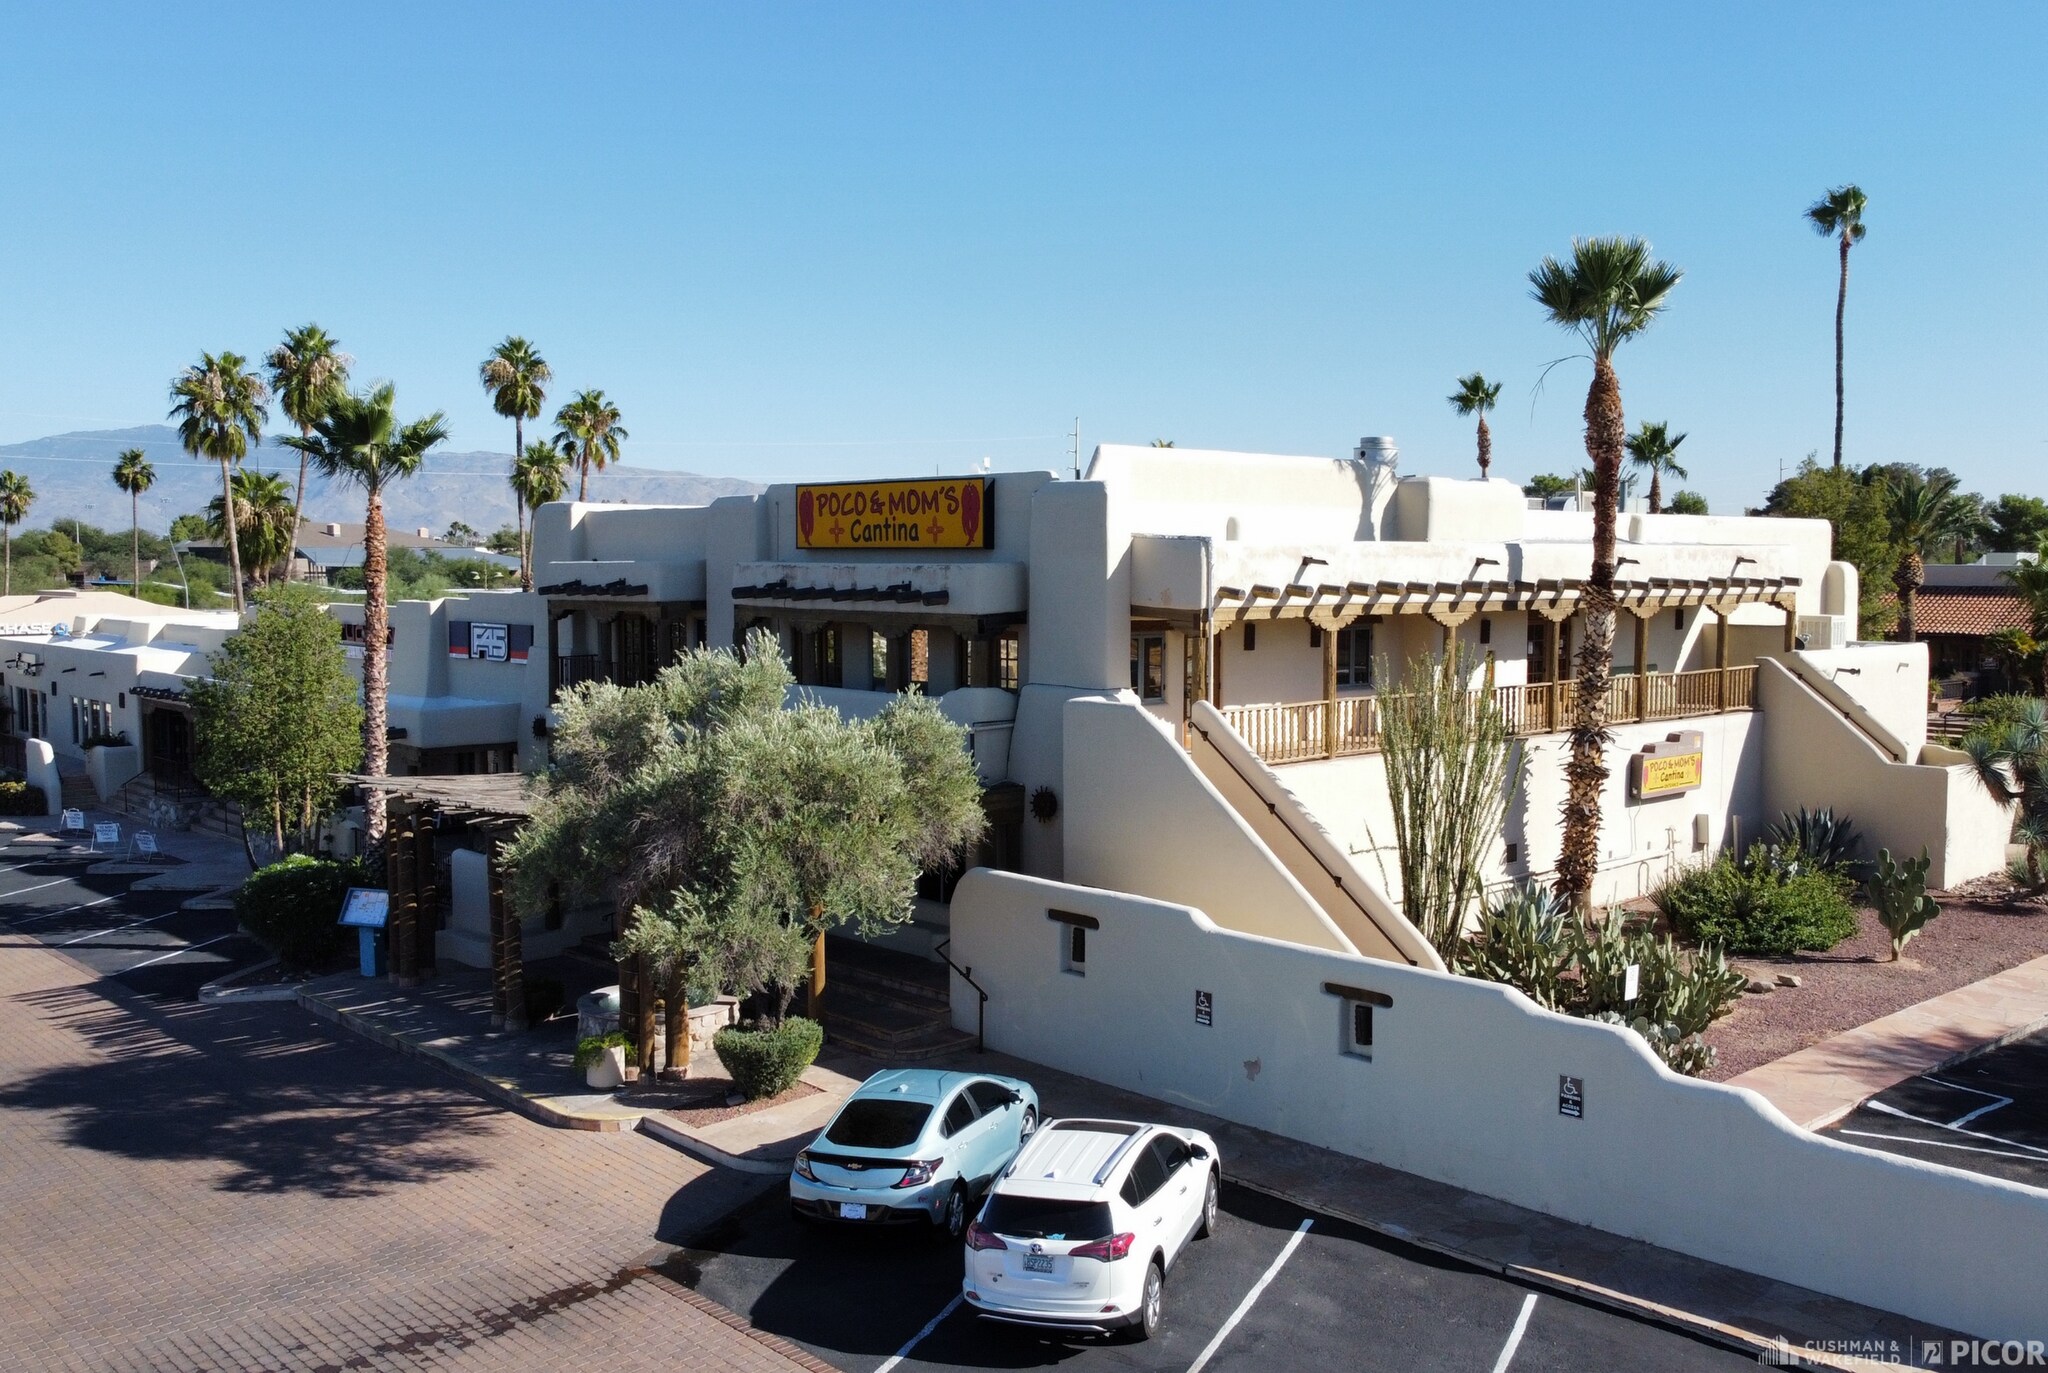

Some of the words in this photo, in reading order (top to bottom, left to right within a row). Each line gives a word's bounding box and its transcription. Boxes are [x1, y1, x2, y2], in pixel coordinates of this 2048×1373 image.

[816, 491, 867, 517] POCO
[870, 490, 885, 516] &
[888, 486, 960, 516] MOM'S
[850, 516, 920, 543] Cantina
[1650, 760, 1667, 772] POCO
[1660, 770, 1684, 782] Cantina
